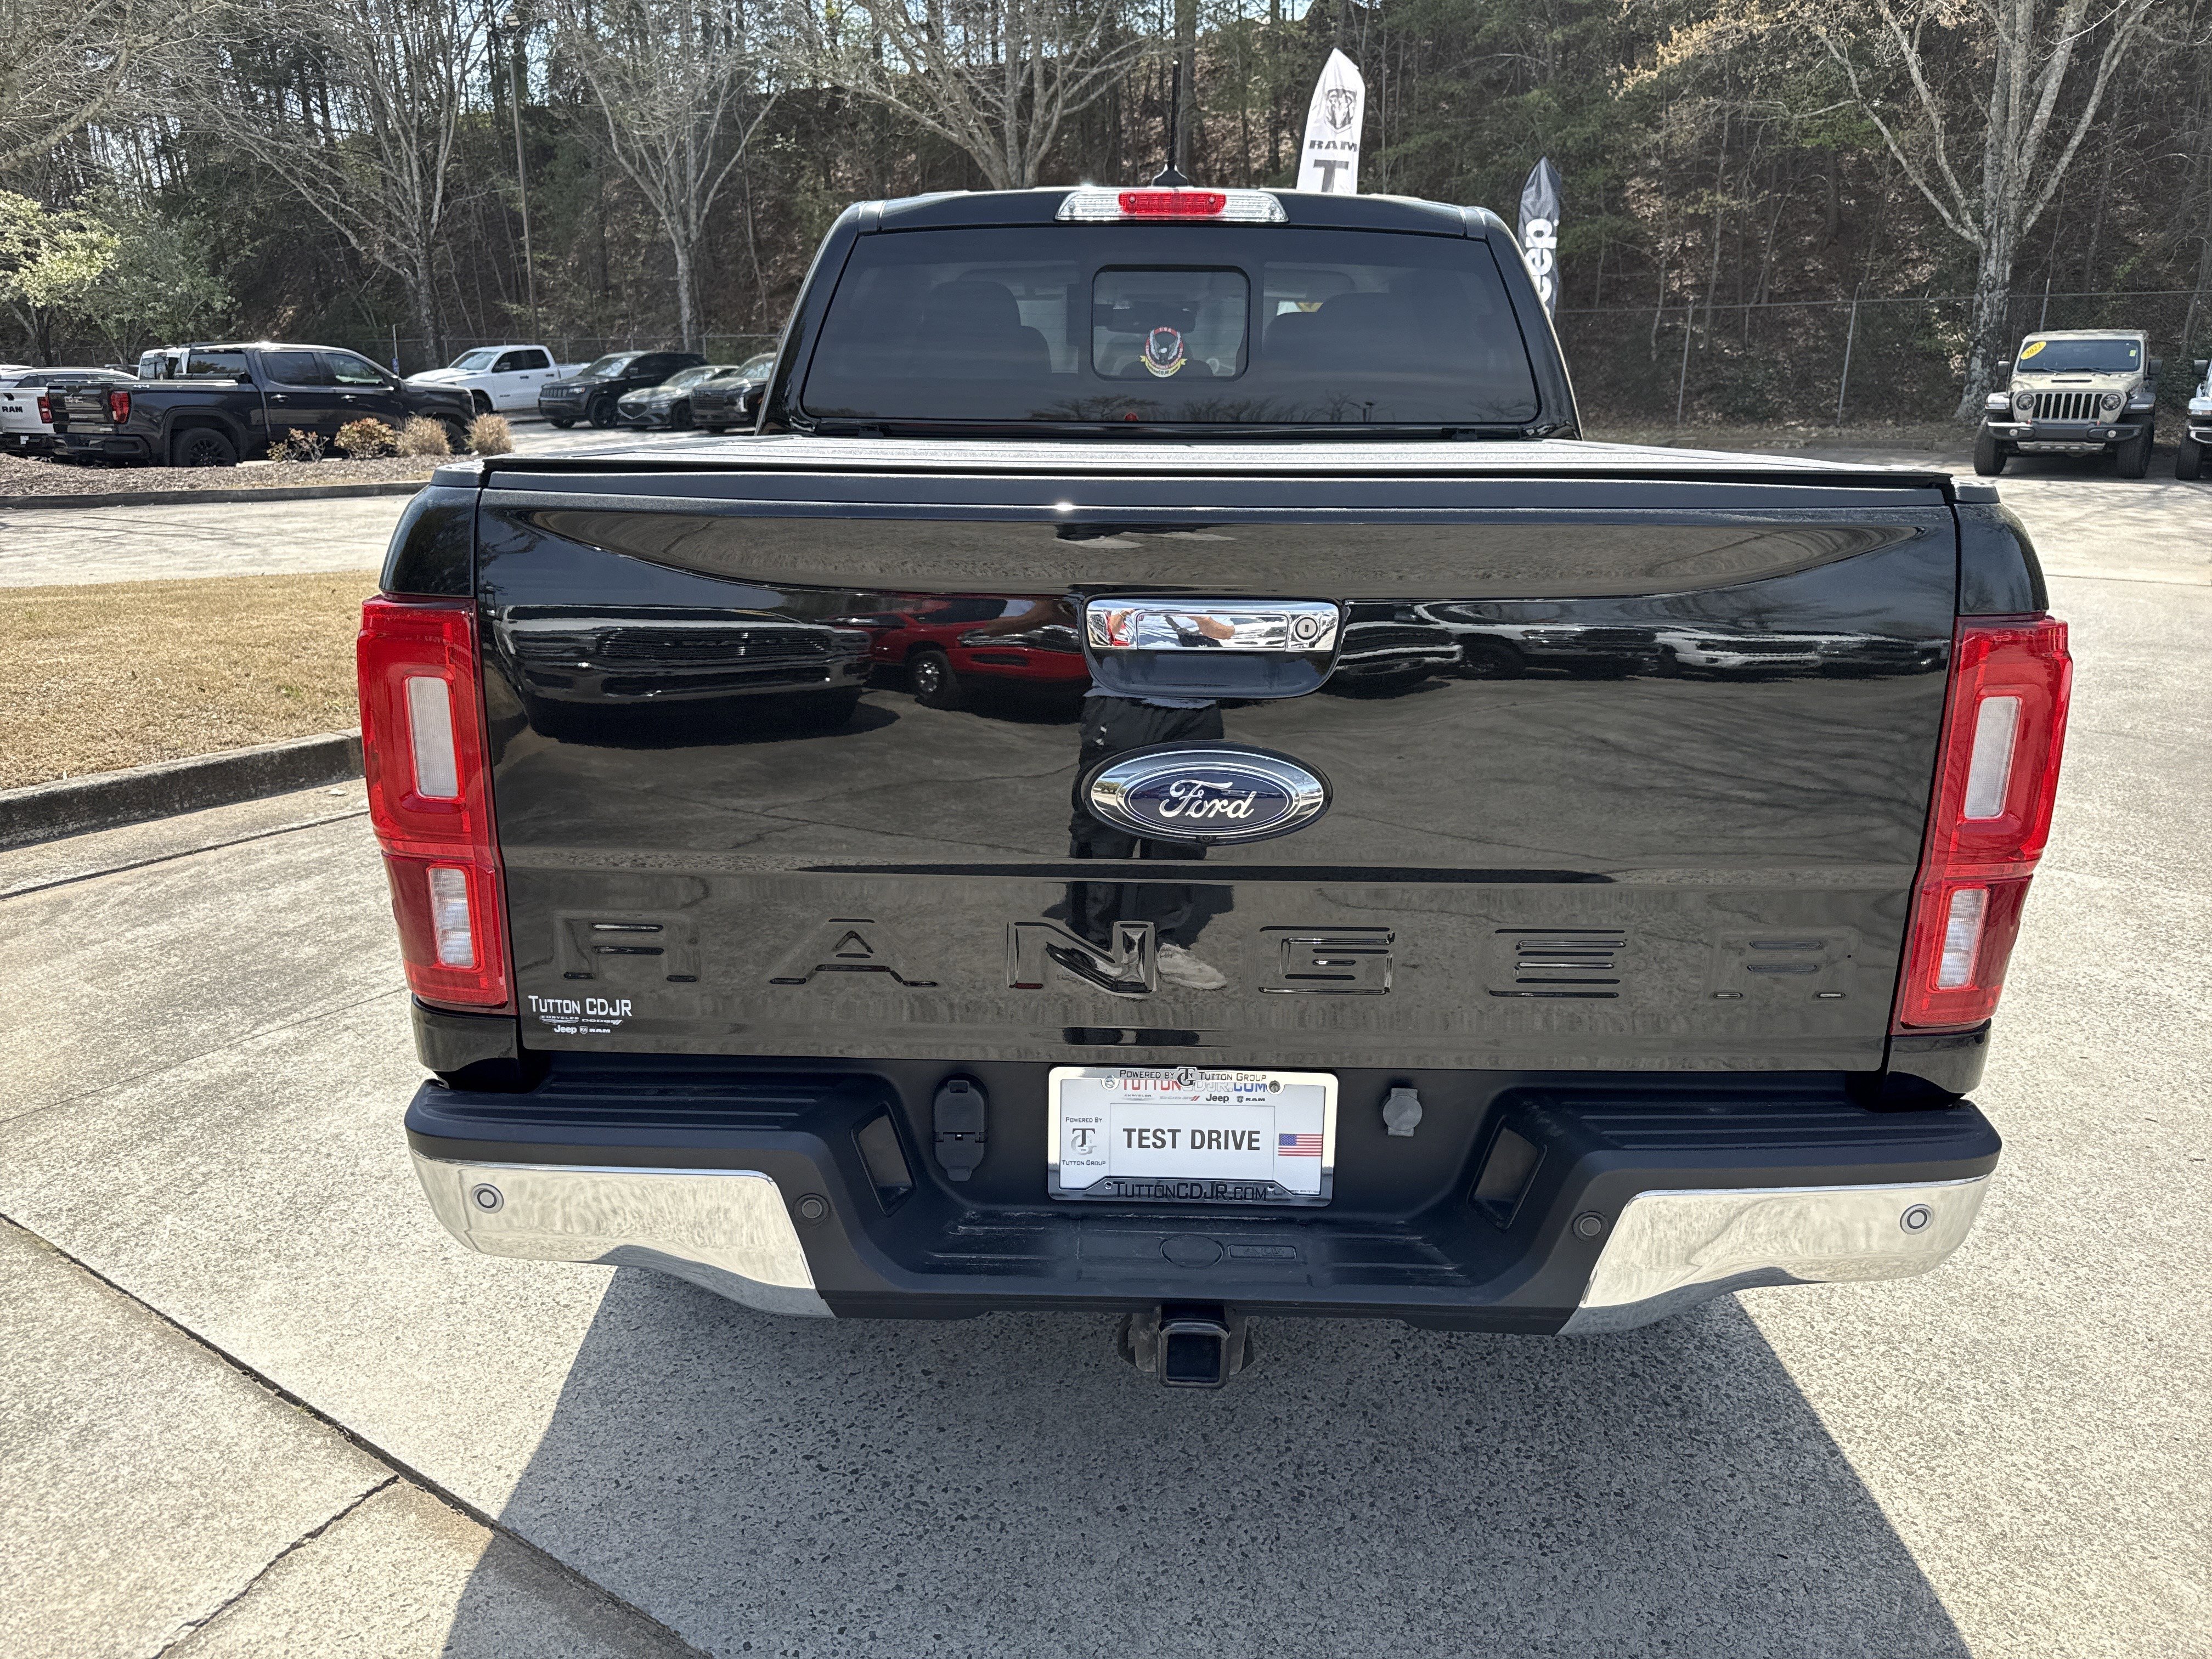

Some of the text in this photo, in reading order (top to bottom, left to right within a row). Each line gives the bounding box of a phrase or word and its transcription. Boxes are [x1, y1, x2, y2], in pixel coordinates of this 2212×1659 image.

[1309, 139, 1357, 153] RAM
[1525, 218, 1558, 316] eep
[1159, 779, 1257, 819] Ford
[585, 998, 633, 1017] CDJR
[554, 1024, 577, 1035] Jeep
[1205, 1093, 1229, 1103] Jeep
[1122, 1128, 1261, 1151] TEST DRIVE
